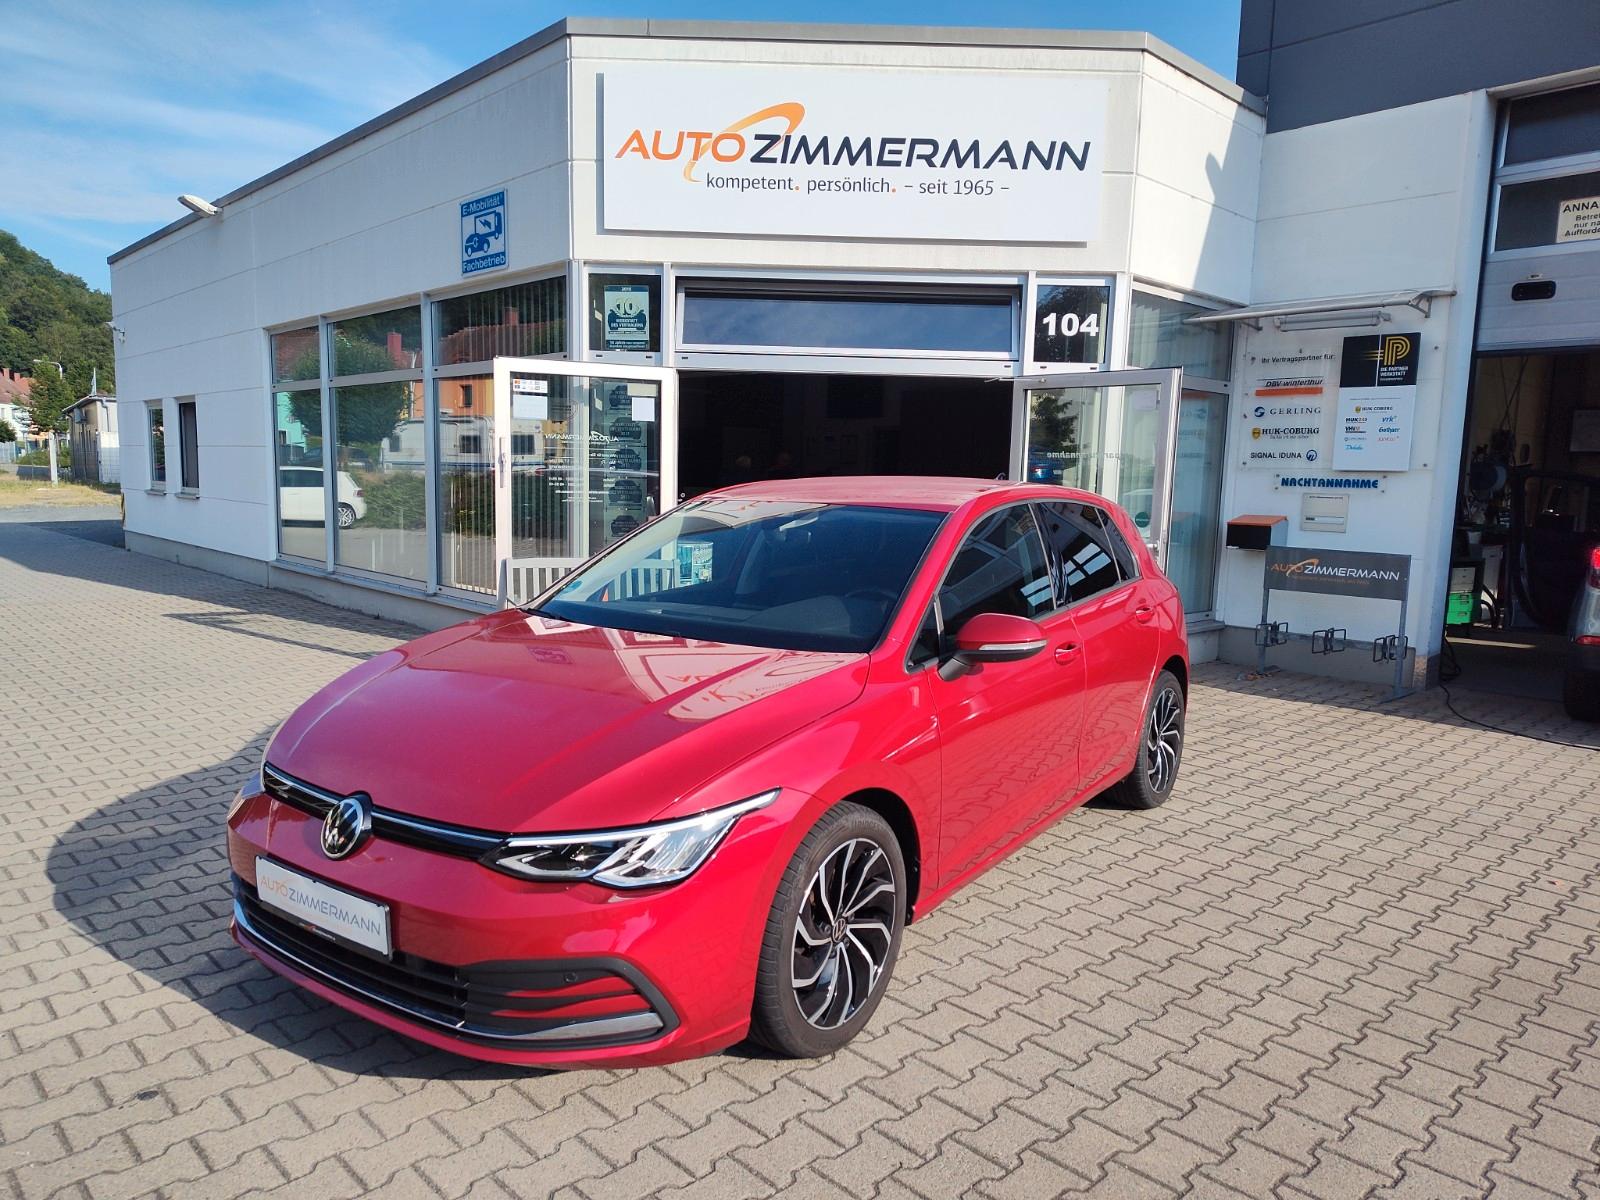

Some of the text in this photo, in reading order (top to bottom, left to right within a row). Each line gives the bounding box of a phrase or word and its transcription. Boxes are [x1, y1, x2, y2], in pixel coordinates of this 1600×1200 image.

[706, 173, 801, 194] kompetent.
[807, 178, 897, 195] persönlich.
[919, 180, 948, 195] seit
[953, 180, 994, 196] 1965
[462, 195, 500, 215] E-Mobilität
[463, 255, 505, 271] Fachbetrieb
[1042, 312, 1099, 337] 104
[1271, 355, 1322, 364] Vertragspartner
[1269, 407, 1321, 415] GERLING
[1262, 427, 1319, 435] HUK-COBURG
[1281, 477, 1379, 489] NACHTANNAHME
